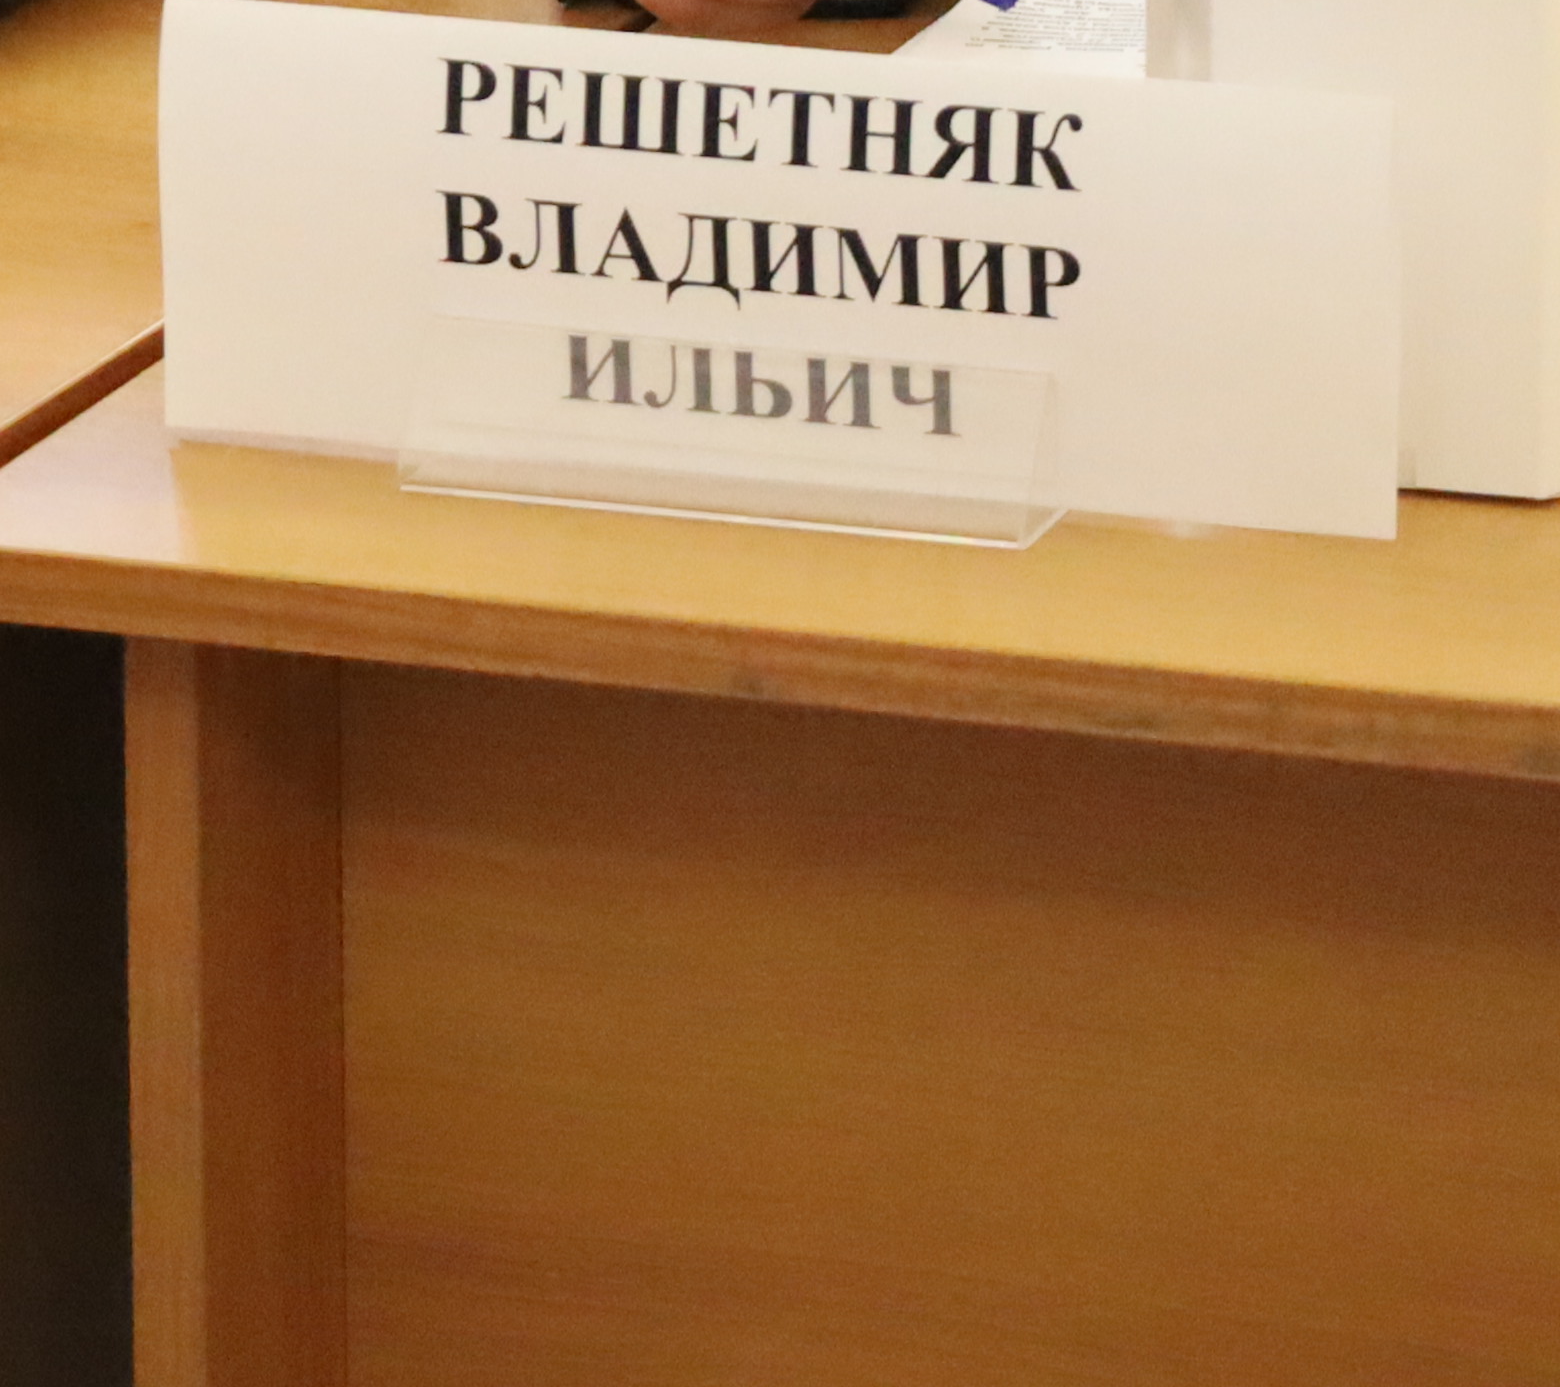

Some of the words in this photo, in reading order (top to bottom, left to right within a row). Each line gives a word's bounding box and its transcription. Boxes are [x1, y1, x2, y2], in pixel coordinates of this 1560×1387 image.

[437, 57, 1083, 191] РЕШЕТНЯК
[436, 188, 1082, 320] ВЛАДИМИР
[561, 335, 963, 437] ИЛЬИЧ
